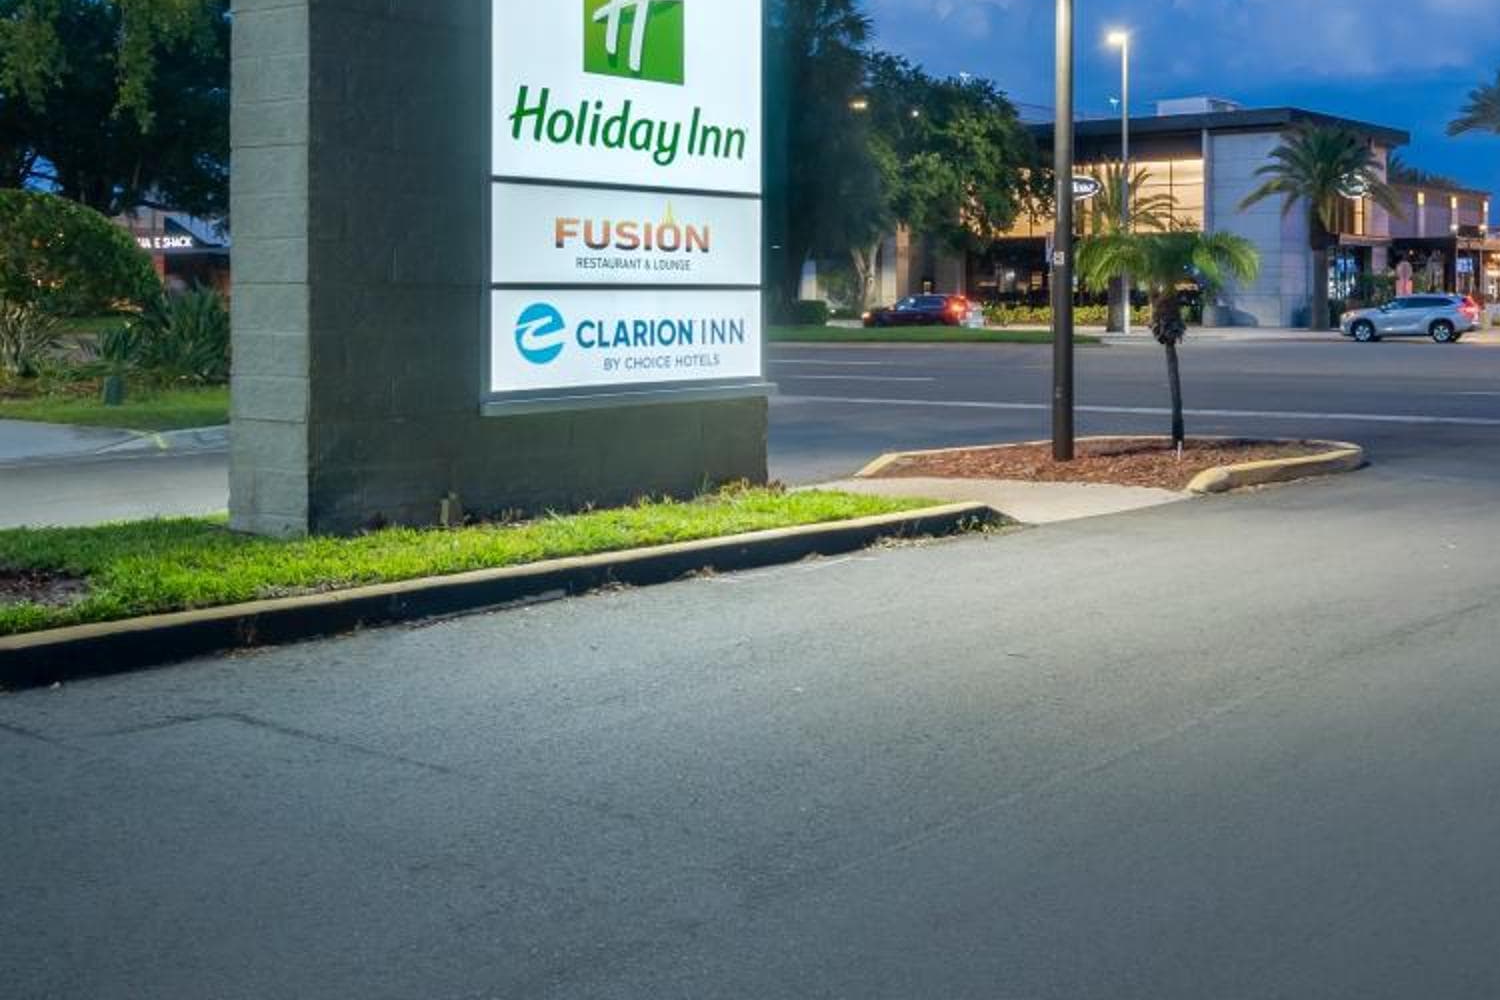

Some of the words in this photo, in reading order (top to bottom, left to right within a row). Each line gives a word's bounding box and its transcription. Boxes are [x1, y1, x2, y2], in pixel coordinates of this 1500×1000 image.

[508, 85, 681, 166] Holiday
[687, 106, 746, 160] Inn
[162, 236, 193, 248] SHACK
[555, 216, 709, 252] FUSION
[575, 257, 642, 271] RESTAURANT
[645, 258, 651, 271] &
[653, 259, 692, 271] LOUNGE
[575, 318, 694, 349] CLARION
[701, 317, 745, 345] INN
[603, 356, 620, 371] BY
[624, 354, 672, 370] CHOICE
[675, 352, 721, 368] HOTELS
